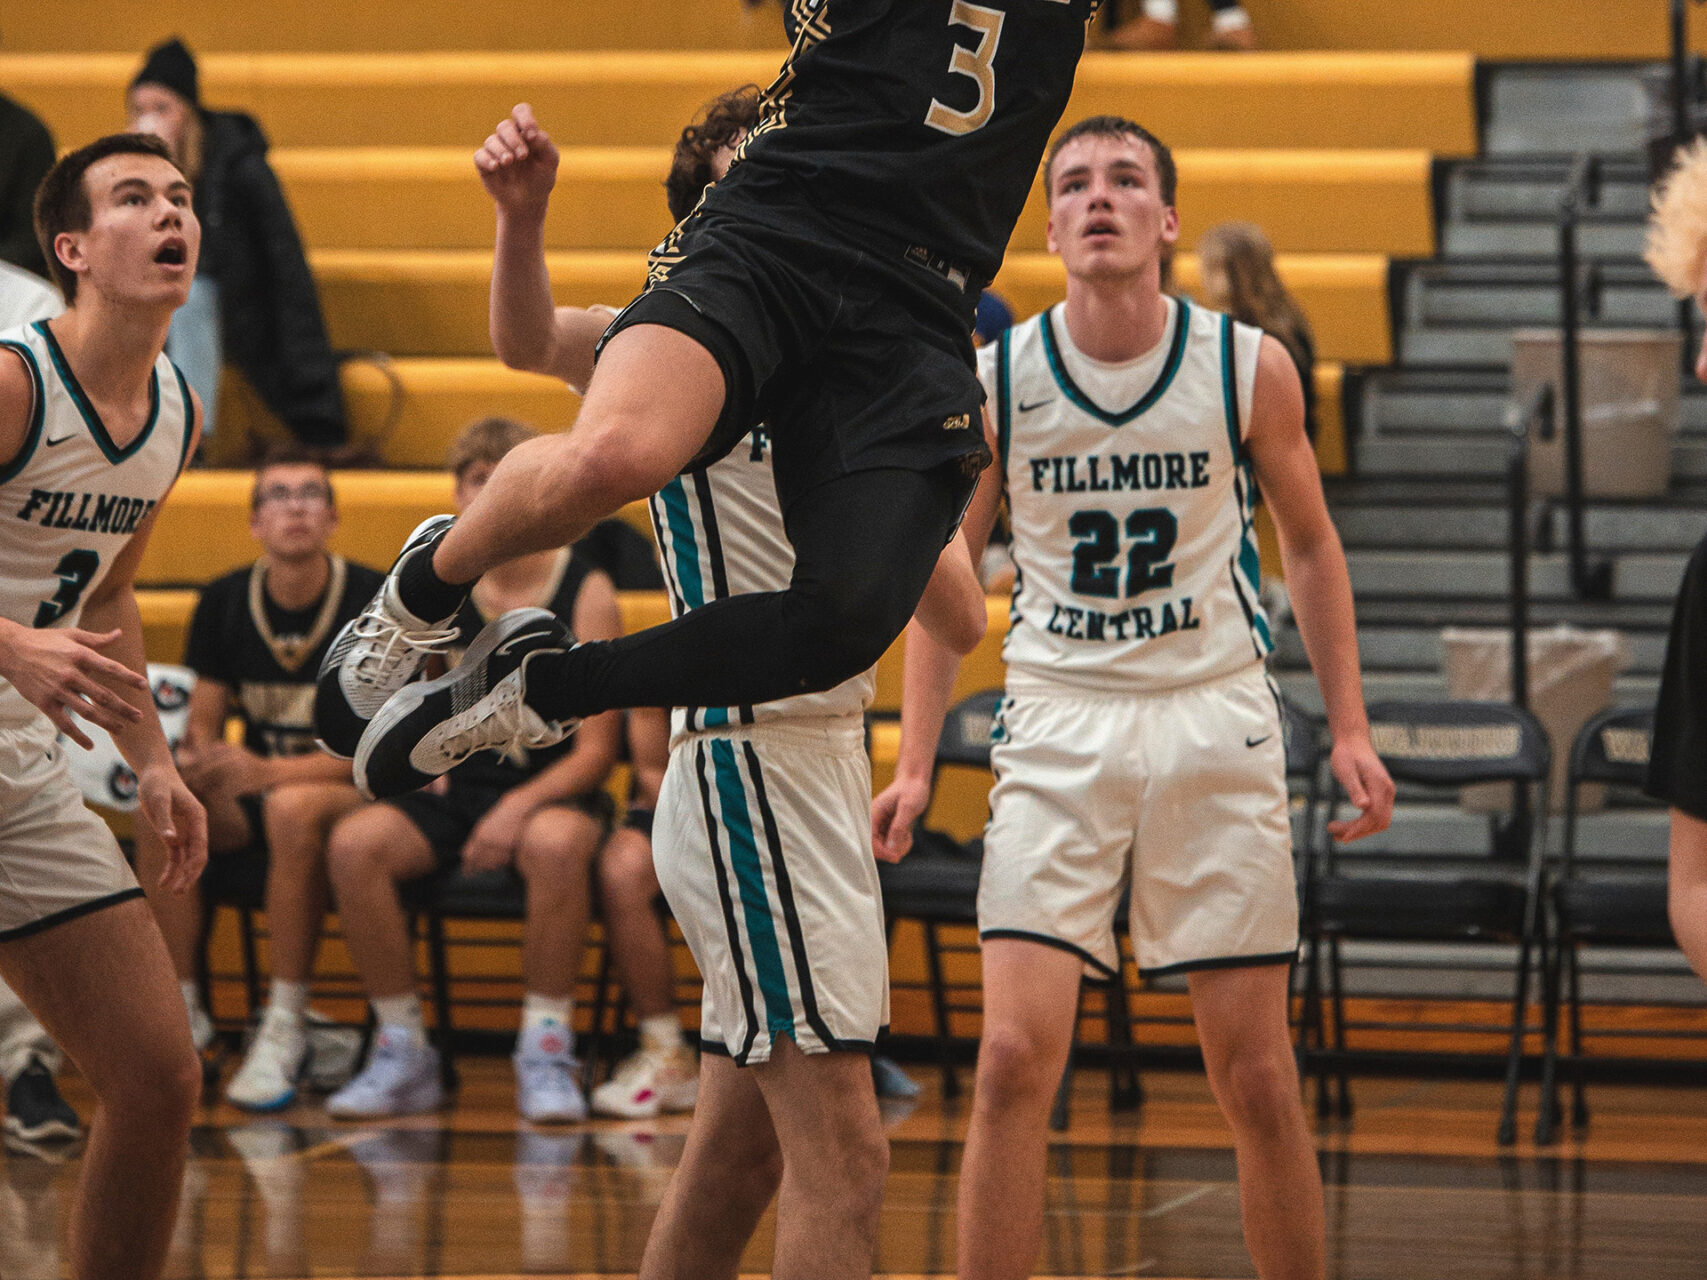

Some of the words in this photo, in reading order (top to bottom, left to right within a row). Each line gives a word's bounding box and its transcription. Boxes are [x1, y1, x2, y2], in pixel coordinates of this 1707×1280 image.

[1030, 451, 1210, 492] FILLMORE
[1068, 507, 1178, 599] 22
[33, 549, 99, 629] 3
[1046, 597, 1200, 640] CENTRAL
